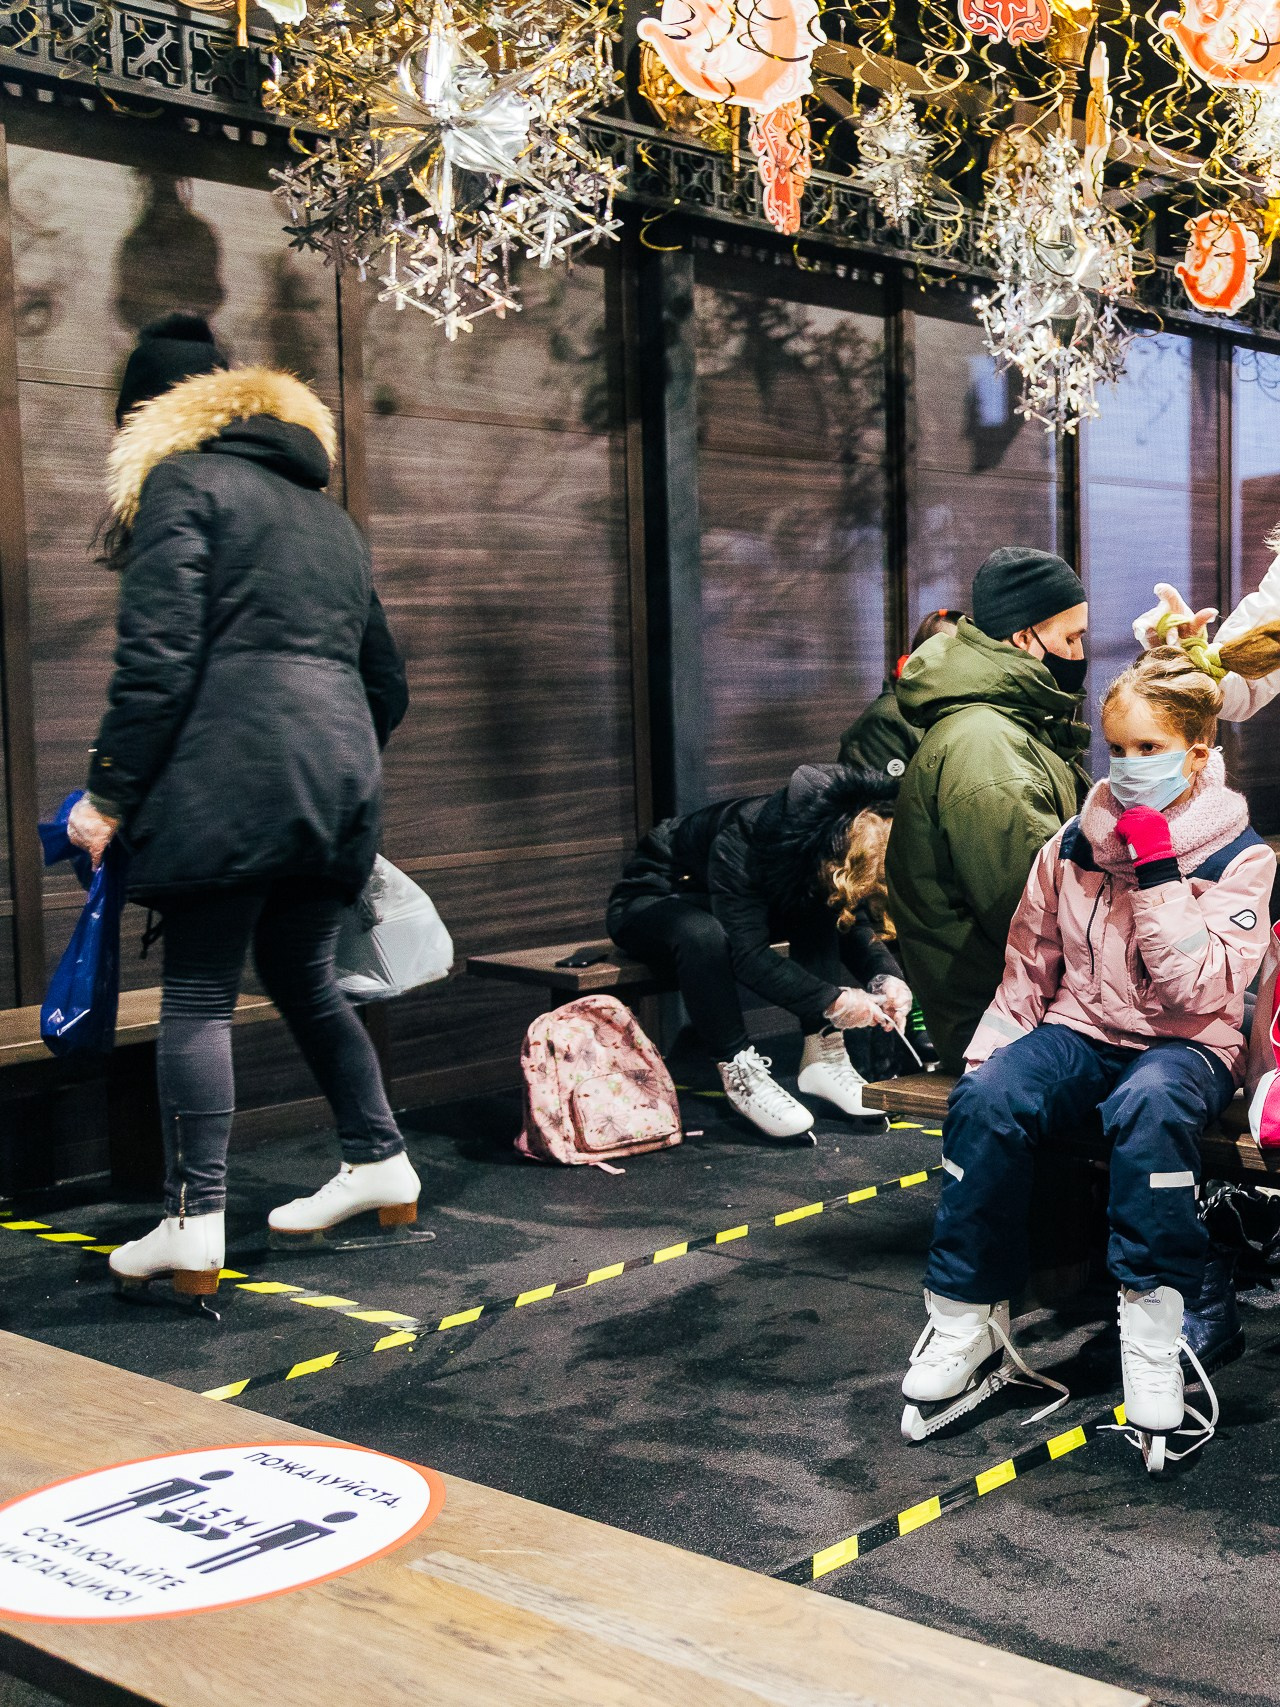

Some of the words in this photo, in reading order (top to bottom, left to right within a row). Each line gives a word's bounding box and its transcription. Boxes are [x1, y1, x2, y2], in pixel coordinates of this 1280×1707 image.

[242, 1452, 402, 1508] ПОЖАЛУЙСТА,
[0, 1541, 143, 1605] ИСТАНЦИЮ!
[22, 1527, 186, 1591] СОБЛЮДАЙТЕ
